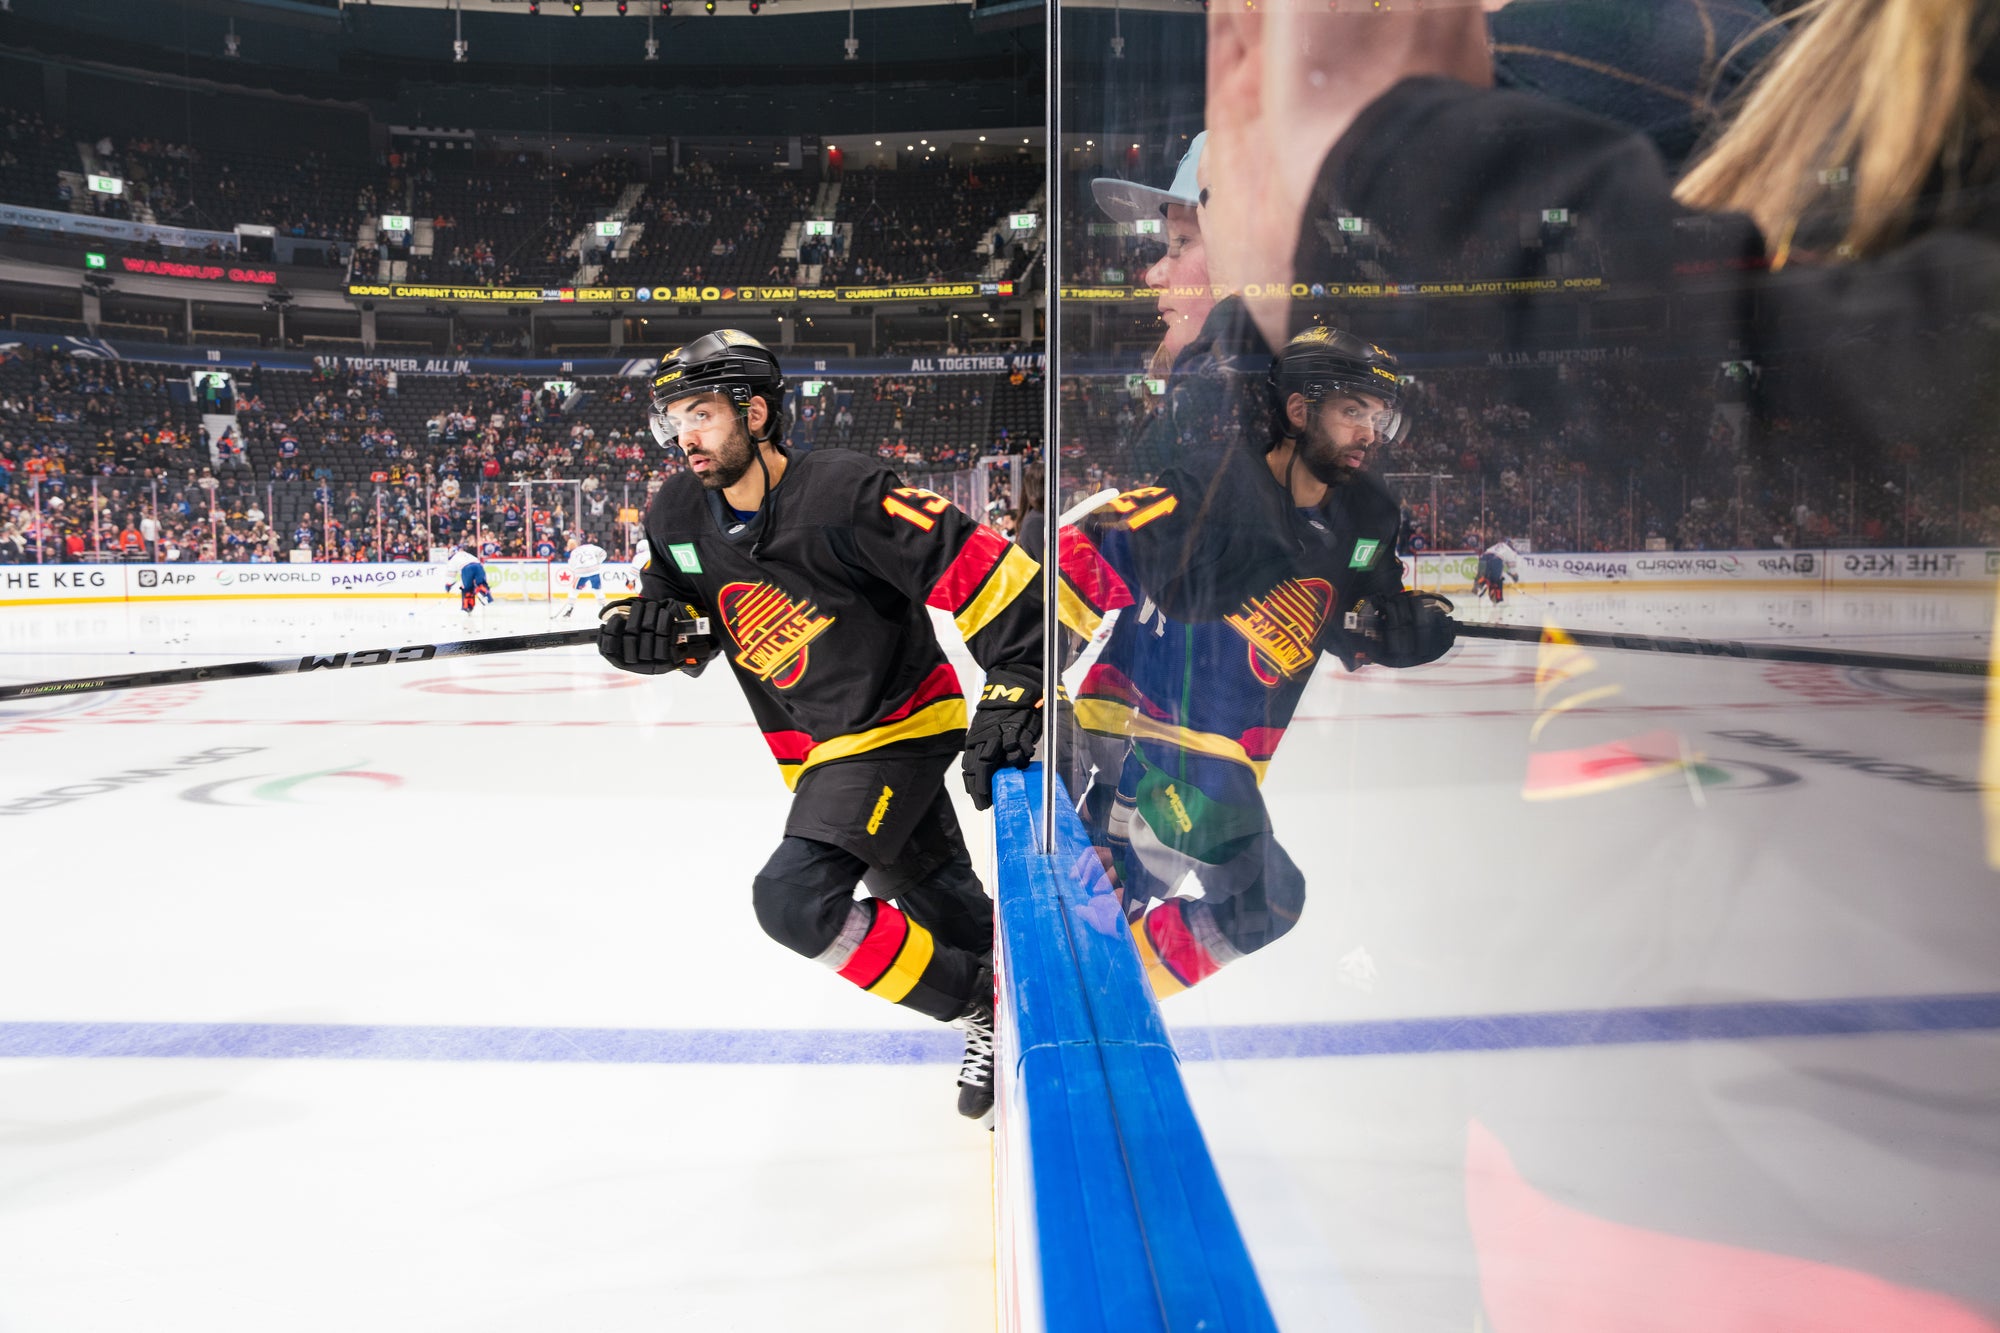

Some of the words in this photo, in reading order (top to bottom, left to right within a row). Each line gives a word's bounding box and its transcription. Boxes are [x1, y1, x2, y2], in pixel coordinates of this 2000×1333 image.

[86, 253, 106, 268] TD
[122, 257, 224, 280] WARMUP
[396, 287, 451, 298] CURRENT
[452, 289, 491, 299] TOTAL:
[579, 289, 612, 300] EDM
[761, 289, 794, 299] VAN
[845, 288, 894, 299] CURRENT
[895, 286, 930, 298] TOTAL:
[344, 356, 421, 372] TOGETHER.
[424, 359, 450, 373] ALL
[452, 359, 471, 374] IN.
[911, 358, 935, 372] ALL
[937, 356, 1008, 372] TOGETHER.
[1012, 354, 1033, 369] ALL
[655, 370, 683, 387] CCM
[0, 571, 40, 588] HE
[54, 571, 106, 588] KEG
[239, 572, 260, 583] DP
[264, 571, 322, 583] WORLD
[331, 570, 397, 587] PANAGO
[401, 569, 423, 580] FOR
[503, 568, 547, 583] fods
[297, 644, 437, 673] CCM
[19, 684, 62, 696] KICKPOINT
[62, 680, 105, 692] ULTRALOW
[866, 785, 893, 836] CCM
